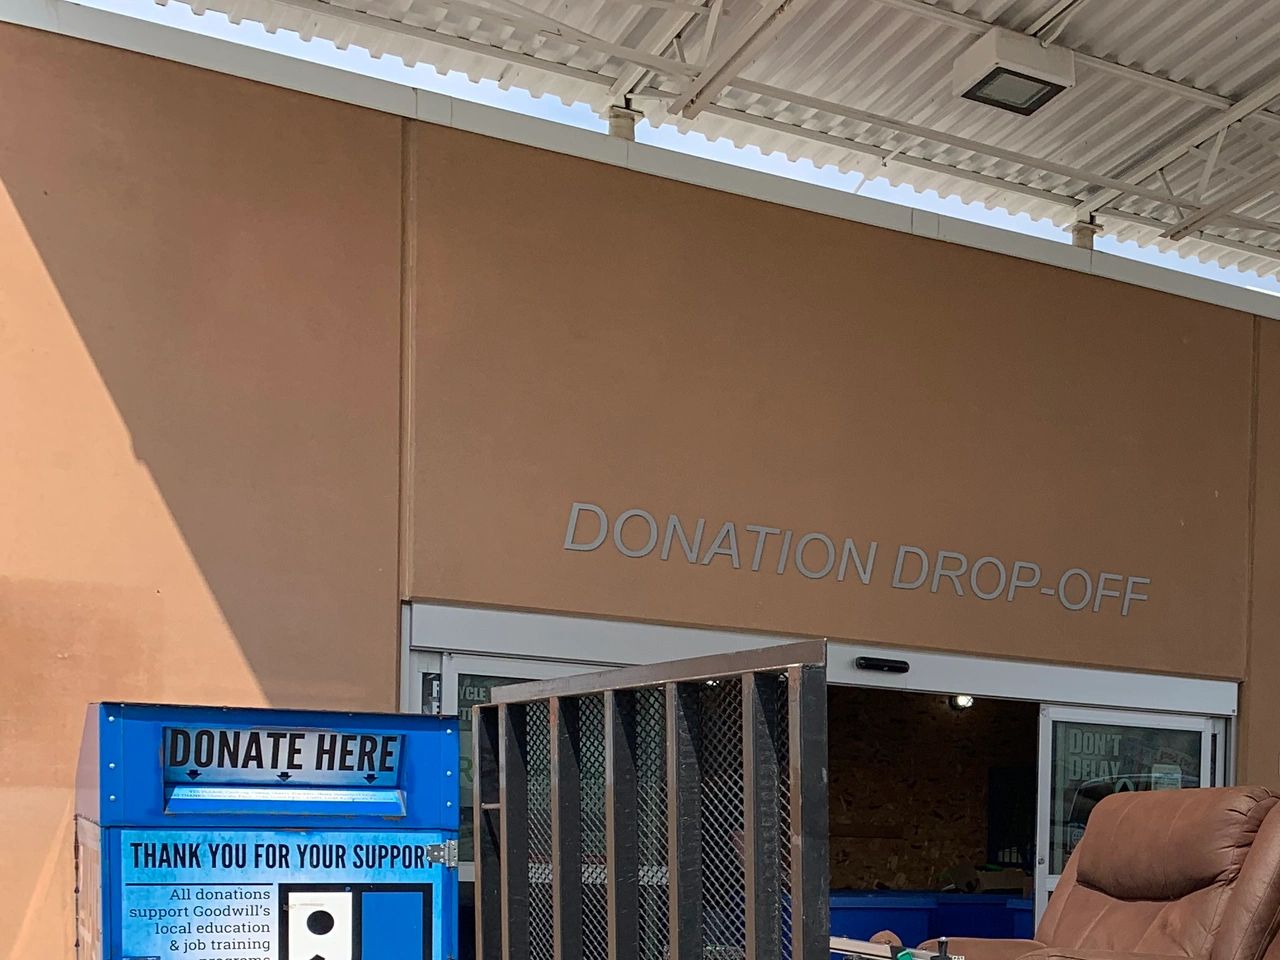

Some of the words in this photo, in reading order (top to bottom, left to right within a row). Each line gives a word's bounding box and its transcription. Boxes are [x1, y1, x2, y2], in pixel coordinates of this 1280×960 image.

[563, 502, 878, 585] DONATION
[891, 545, 1151, 616] DROP-OFF
[169, 728, 305, 770] DONATE
[315, 733, 398, 772] HERE
[1069, 728, 1122, 756] DON'T
[1069, 756, 1120, 783] DELAY
[130, 842, 202, 869] THANK
[208, 843, 247, 869] YOU
[254, 843, 290, 869] FOR
[297, 843, 346, 869] YOUR
[170, 888, 192, 900] All
[195, 887, 271, 900] donations
[129, 906, 189, 920] support
[193, 904, 271, 917] Goodwill's
[155, 922, 192, 935] local
[196, 921, 270, 934] education
[169, 939, 180, 952] &
[183, 939, 206, 953] job
[211, 938, 271, 952] training
